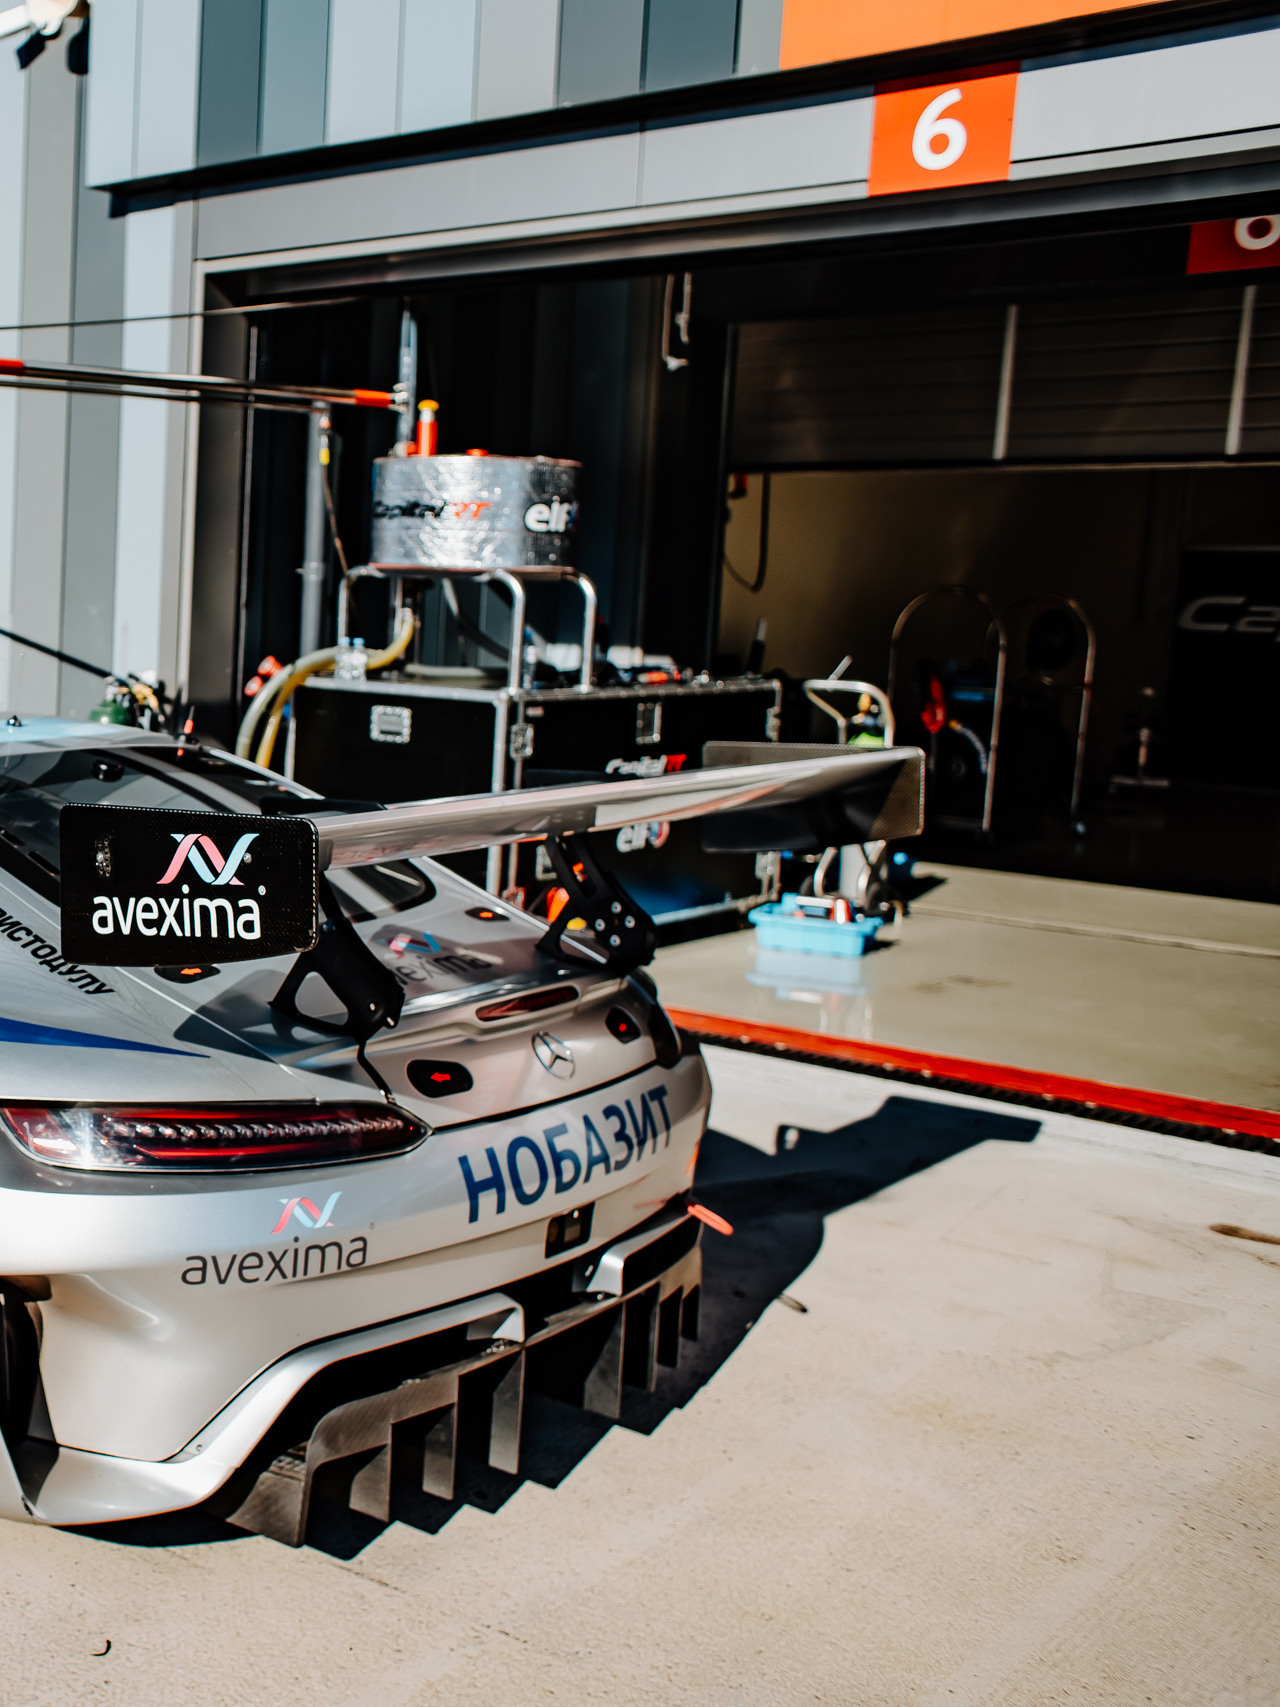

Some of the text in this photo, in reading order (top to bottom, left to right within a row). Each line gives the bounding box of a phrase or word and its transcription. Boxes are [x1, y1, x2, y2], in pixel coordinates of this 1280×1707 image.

[912, 88, 967, 170] 6
[524, 495, 570, 533] elf
[458, 1084, 672, 1224] НОБАЗИТ
[181, 1236, 369, 1286] avexima
